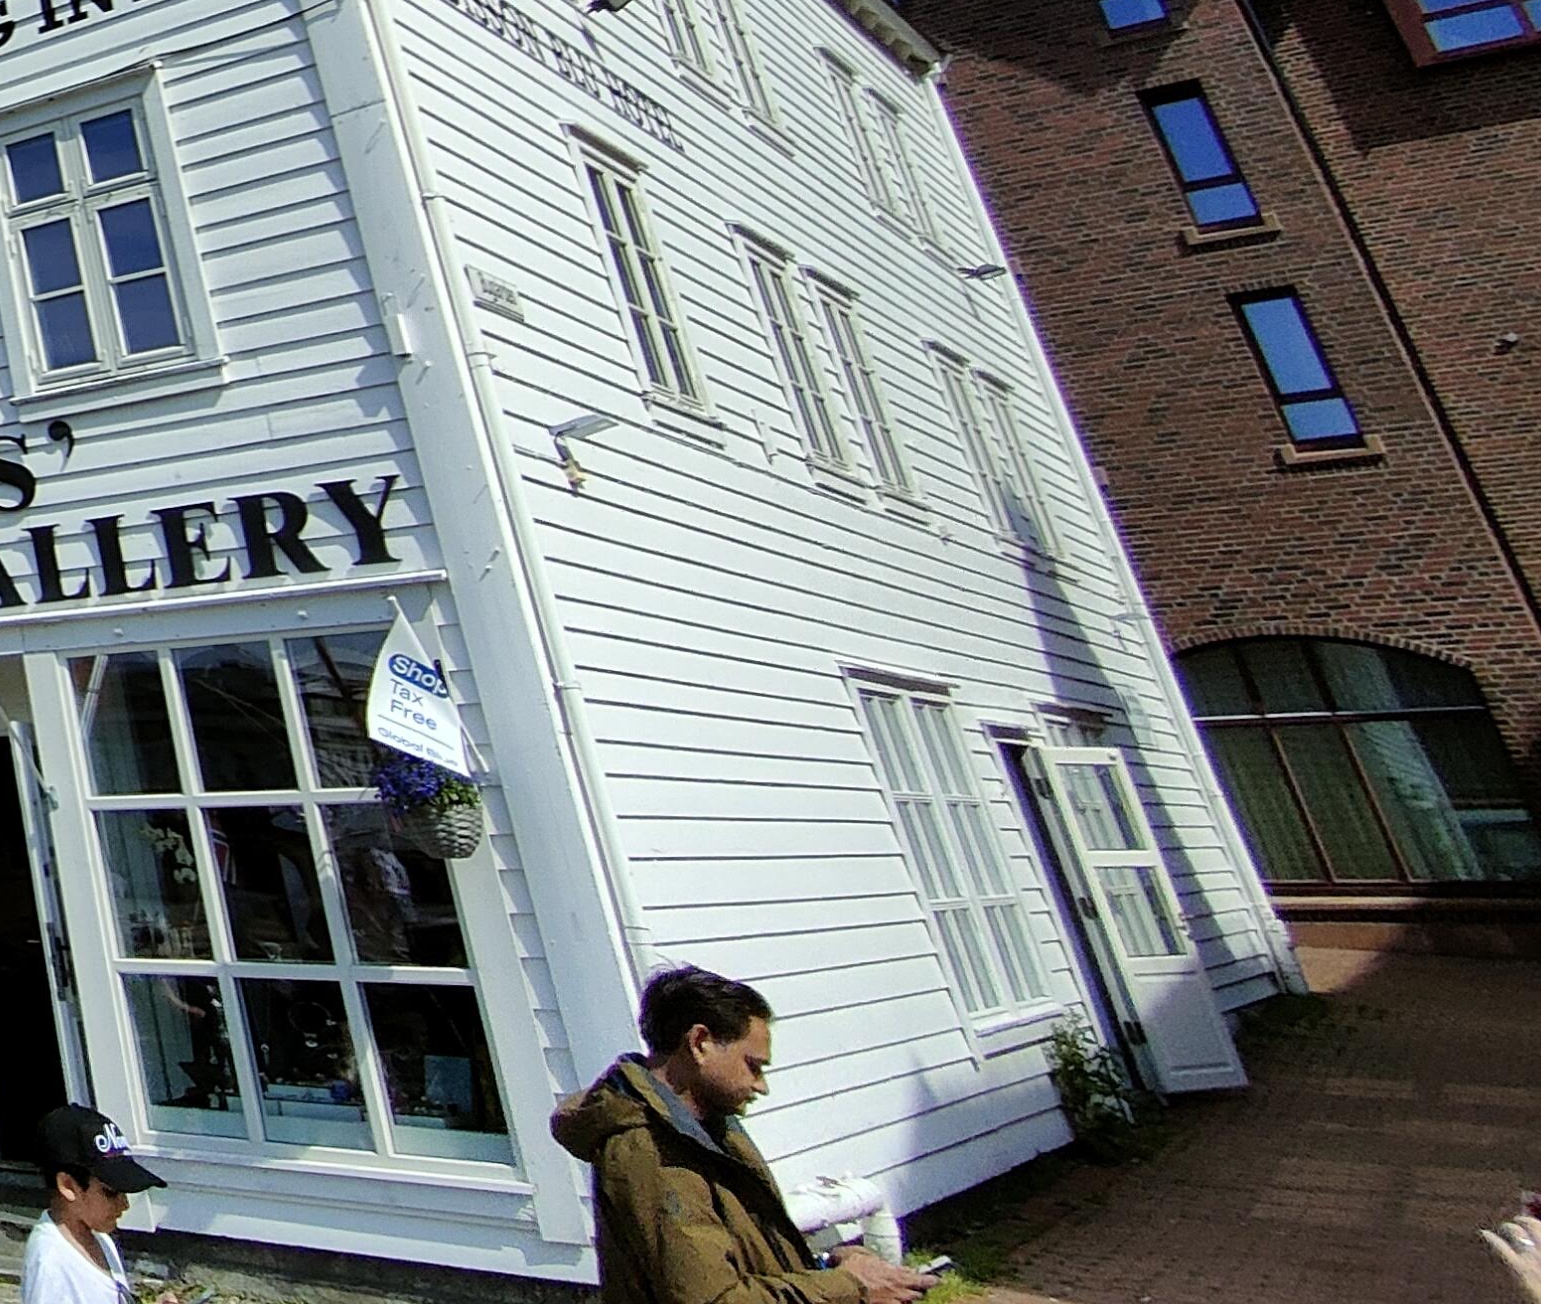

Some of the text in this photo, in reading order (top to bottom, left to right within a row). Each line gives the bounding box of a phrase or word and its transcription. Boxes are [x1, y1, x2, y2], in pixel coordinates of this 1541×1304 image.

[546, 30, 600, 99] BLU
[601, 66, 685, 152] HOTEL
[390, 678, 424, 707] Tax
[392, 656, 448, 695] Shop
[390, 699, 437, 730] Free
